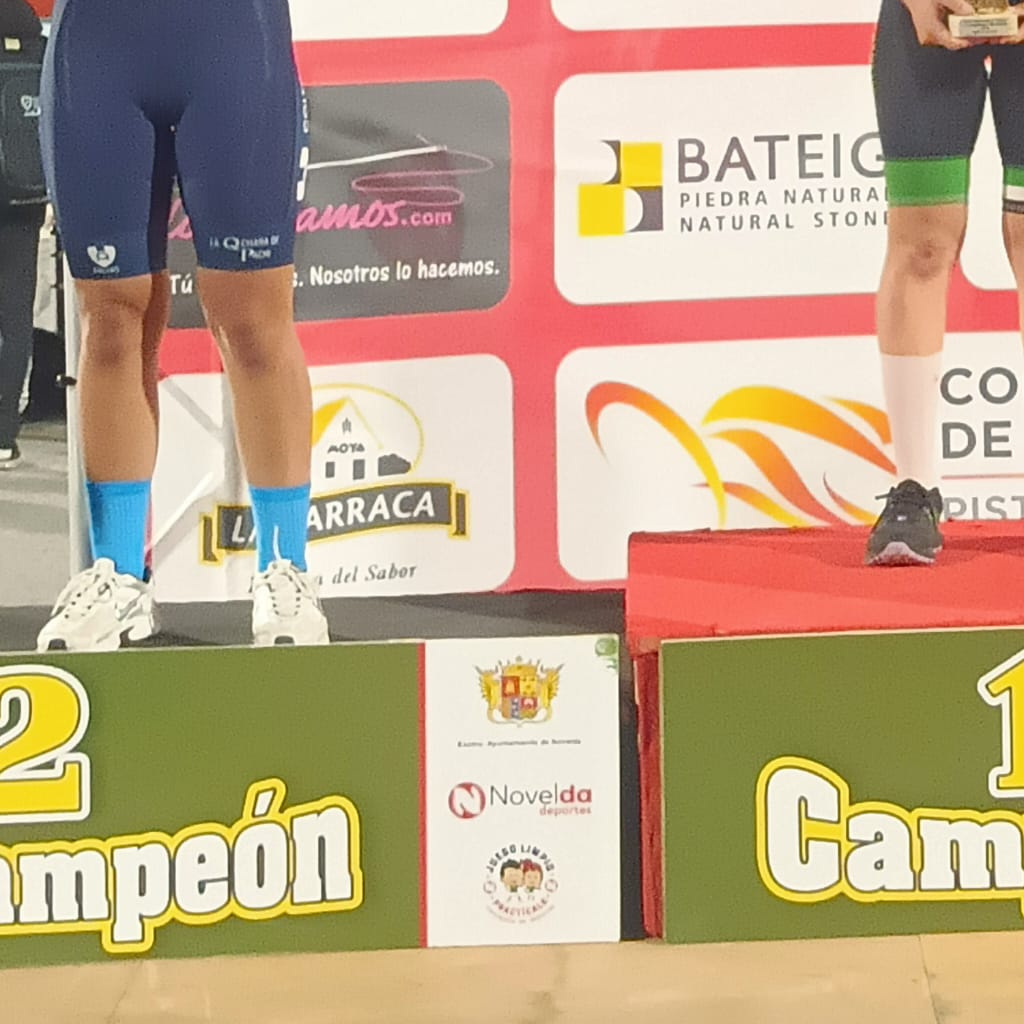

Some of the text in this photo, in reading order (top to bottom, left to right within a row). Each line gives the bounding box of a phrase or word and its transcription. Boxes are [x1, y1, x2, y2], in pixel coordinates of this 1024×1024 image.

[679, 190, 768, 208] PIEDRA
[679, 210, 794, 234] NATURAL
[170, 273, 193, 296] Tú
[309, 264, 390, 287] Nosotros
[395, 262, 411, 281] lo
[417, 258, 501, 280] hacemos.
[327, 442, 366, 454] MOYA
[941, 421, 1013, 459] DE
[305, 490, 436, 532] ARRACA
[331, 567, 358, 585] del
[364, 561, 418, 582] Sabor
[489, 782, 593, 806] Novelda
[539, 805, 592, 817] deportes
[0, 779, 362, 952] mpeón
